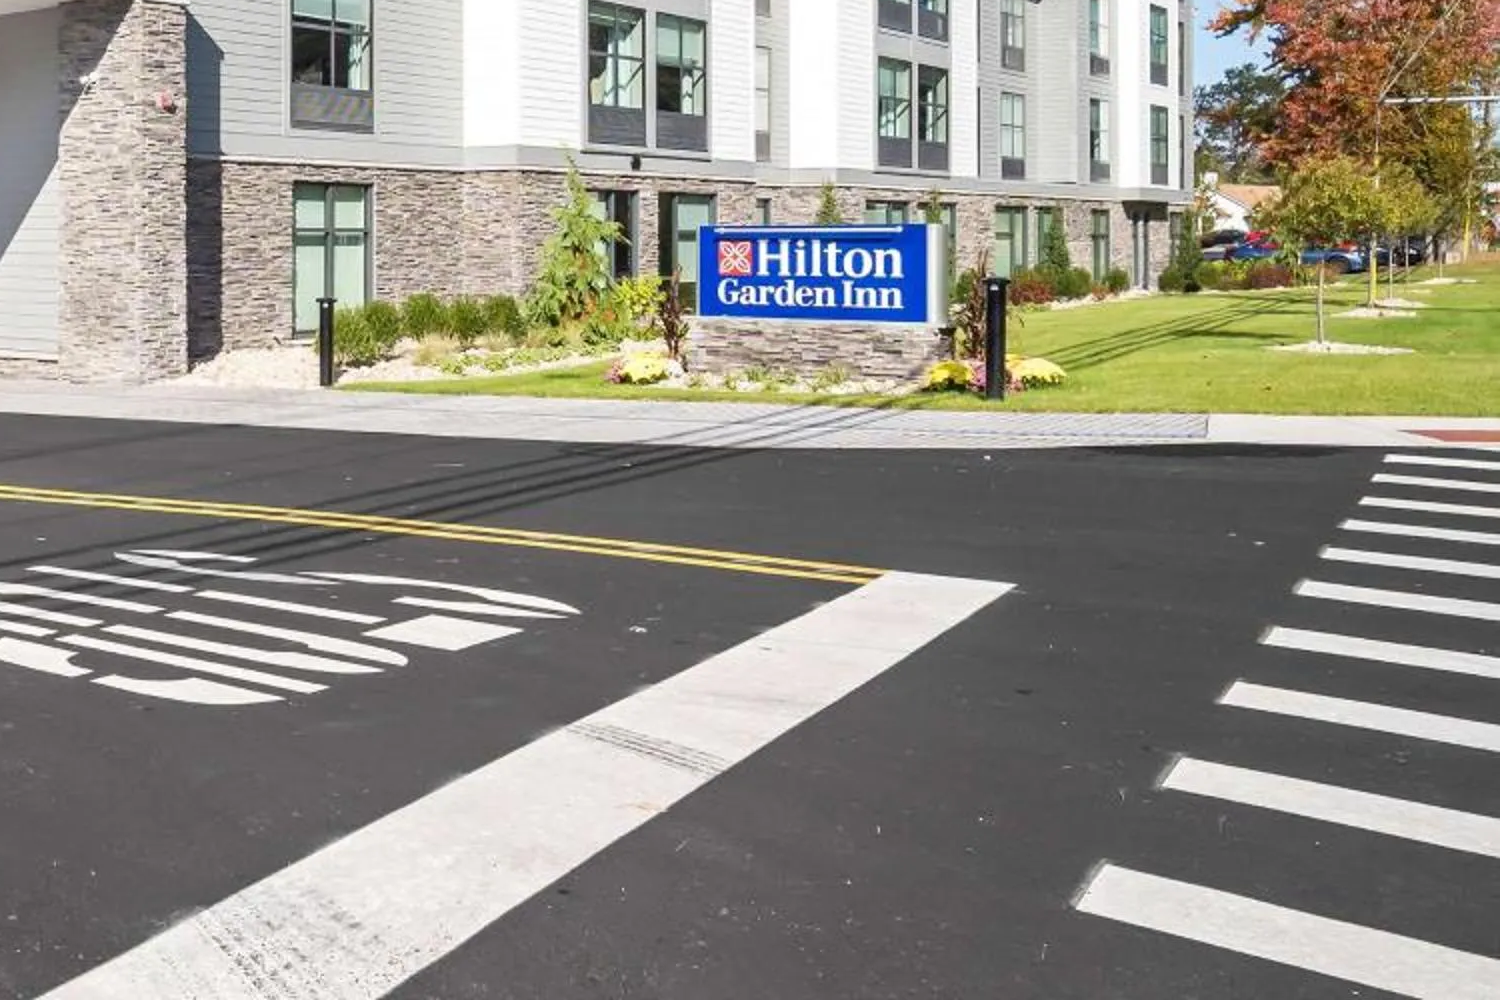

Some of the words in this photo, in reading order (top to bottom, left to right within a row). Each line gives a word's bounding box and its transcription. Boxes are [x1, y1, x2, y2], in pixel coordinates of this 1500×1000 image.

[756, 239, 904, 278] Hilton
[717, 278, 837, 307] Garden
[842, 281, 904, 309] Inn
